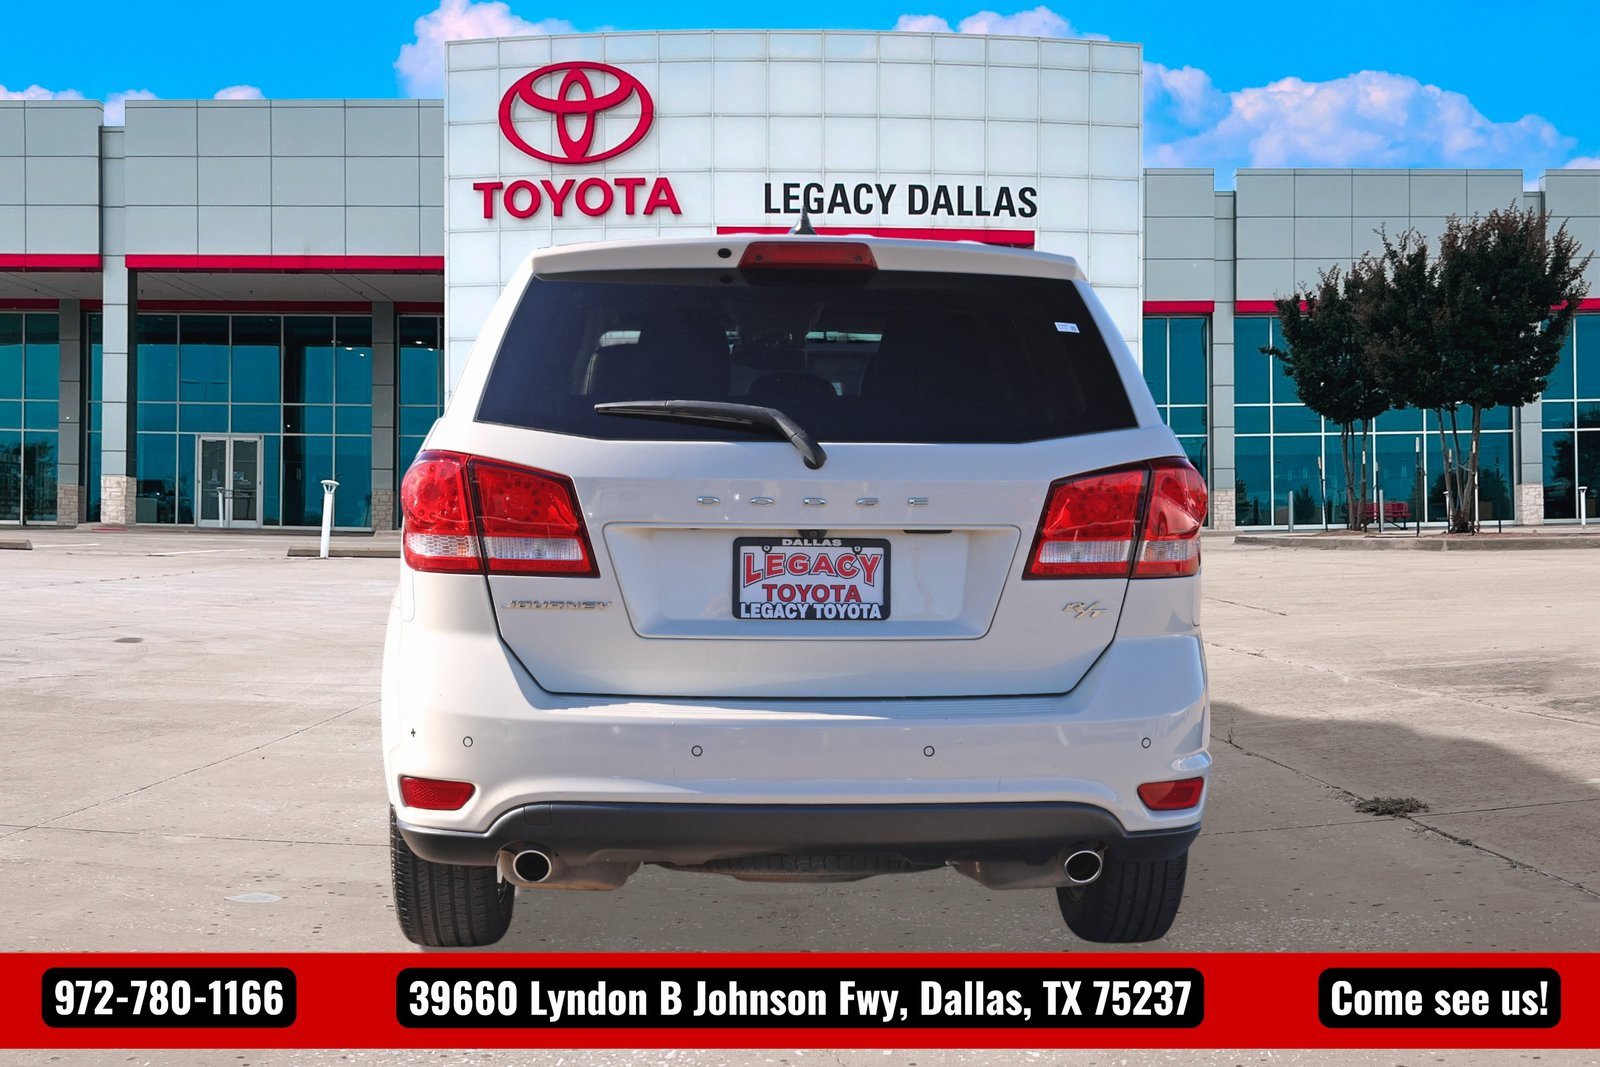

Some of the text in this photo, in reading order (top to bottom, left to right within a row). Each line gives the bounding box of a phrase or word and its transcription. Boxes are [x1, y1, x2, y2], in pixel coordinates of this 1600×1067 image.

[473, 177, 682, 219] TOYOTA
[764, 182, 1038, 218] LEGACY DALLAS
[697, 495, 929, 506] DODGE
[781, 538, 842, 547] DALLAS
[743, 553, 882, 587] LEGACY
[762, 584, 862, 603] TOYOTA
[740, 602, 881, 619] LEGACY TOYOTA
